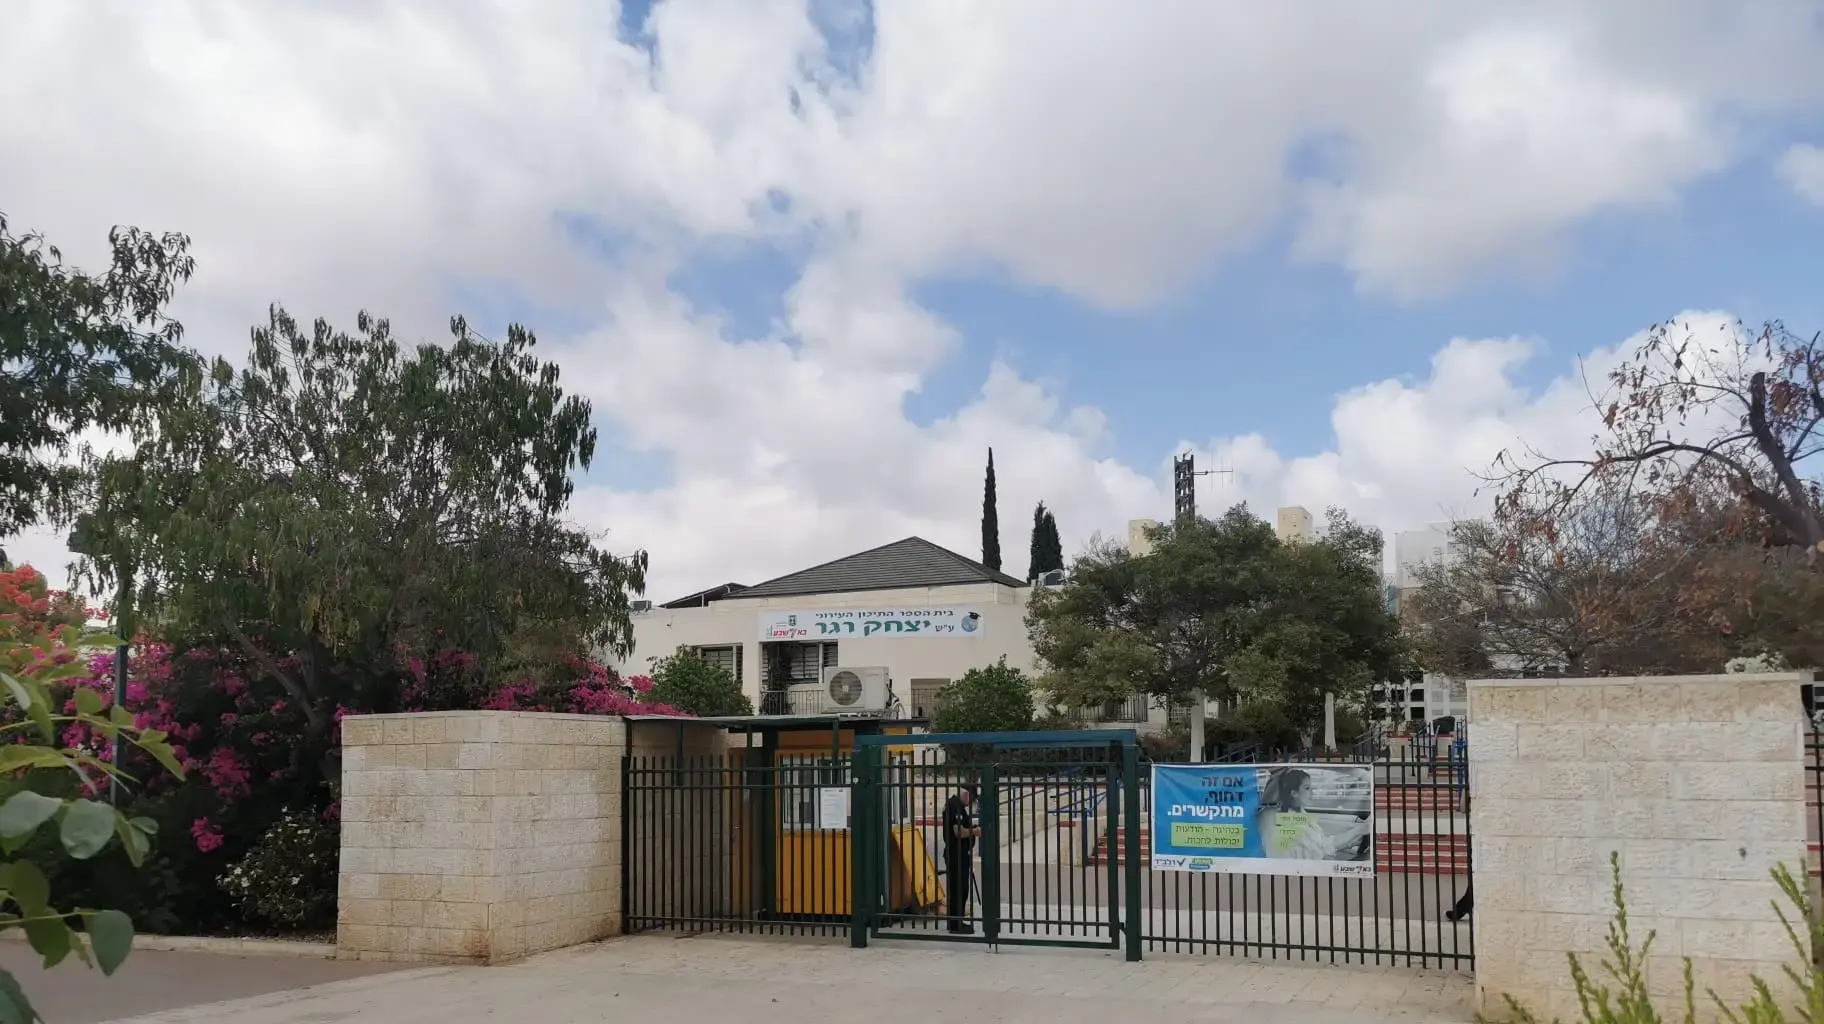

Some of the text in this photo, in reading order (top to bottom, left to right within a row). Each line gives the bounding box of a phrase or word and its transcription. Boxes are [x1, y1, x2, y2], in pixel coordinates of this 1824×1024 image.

[815, 611, 853, 619] העירוני
[815, 621, 855, 634] רגר
[863, 619, 931, 637] יצחק
[1201, 776, 1244, 787] אם זה
[1167, 804, 1244, 820] מתקשרים.
